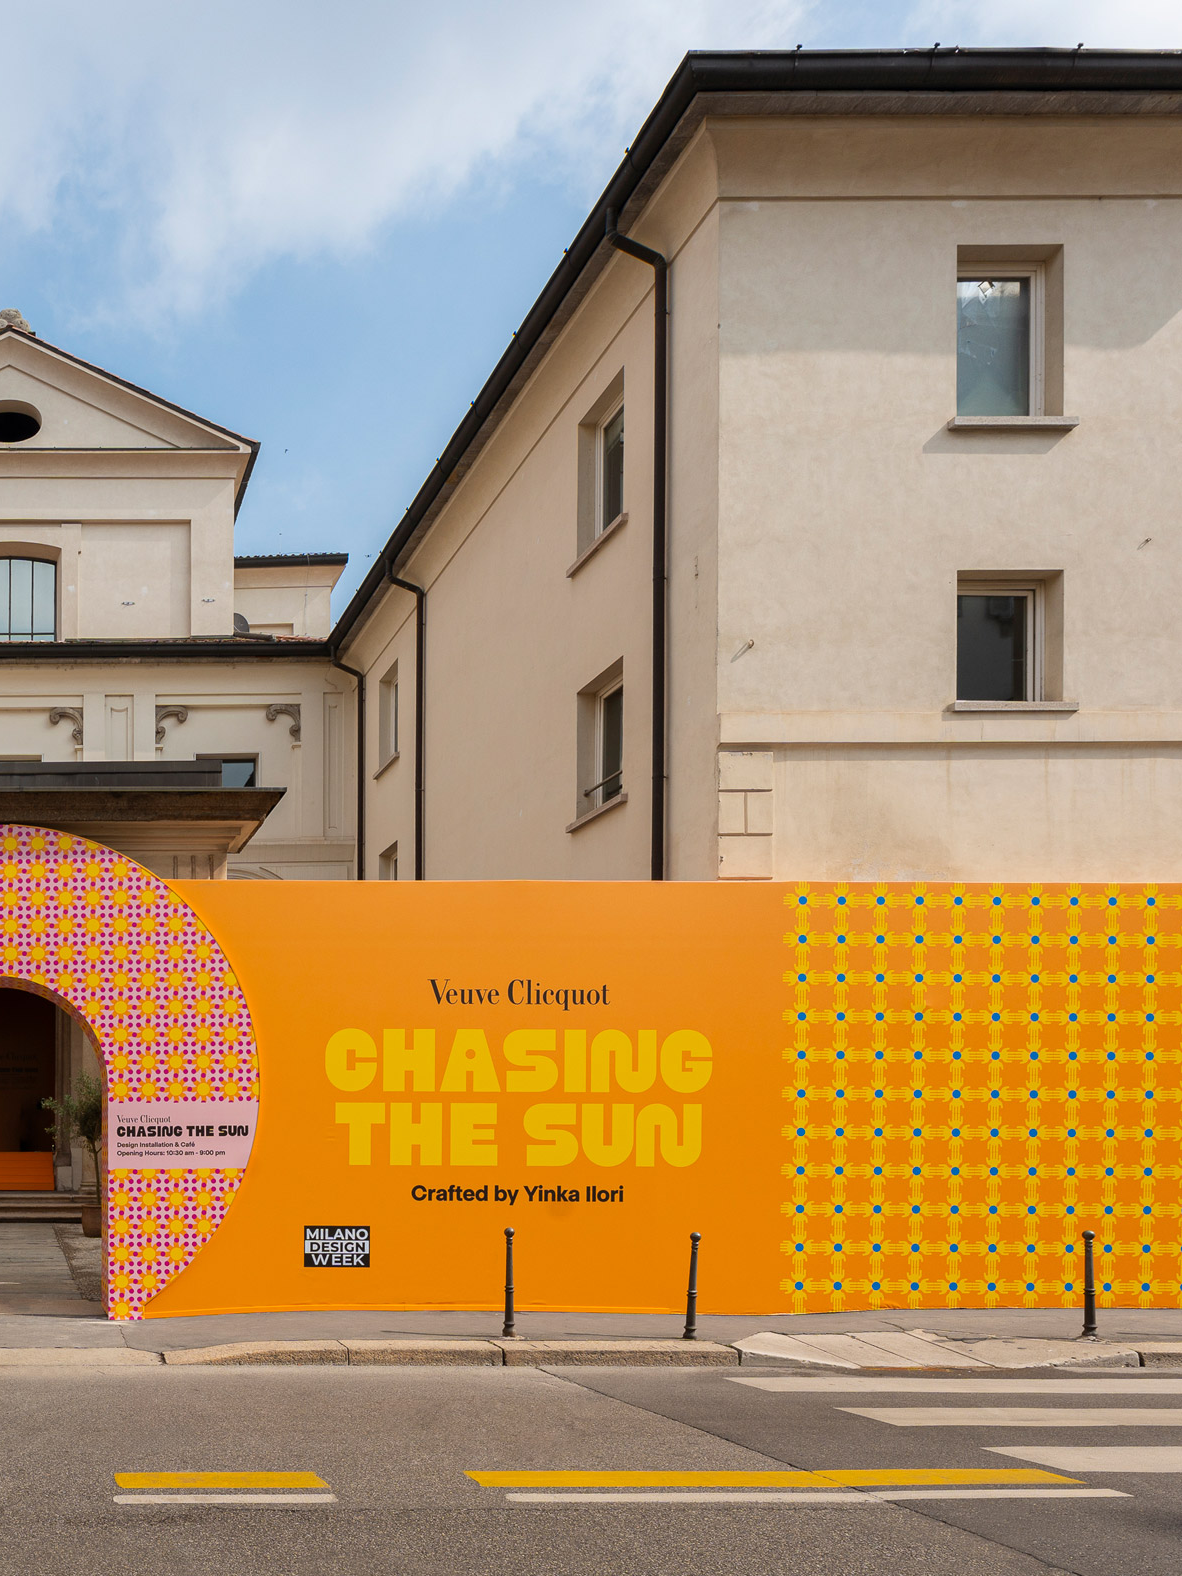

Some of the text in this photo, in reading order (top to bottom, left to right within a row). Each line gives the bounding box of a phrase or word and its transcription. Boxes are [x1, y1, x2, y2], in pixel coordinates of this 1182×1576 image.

[428, 979, 611, 1011] Veuve Clicquot
[324, 1028, 713, 1093] CHASING
[117, 1115, 171, 1124] Veuve Clicquot
[117, 1125, 249, 1137] CHASING THE SUN
[335, 1102, 703, 1167] THE SUN
[411, 1185, 624, 1206] Crafted by Yinka Ilori
[306, 1228, 369, 1240] MILANO
[310, 1242, 366, 1252] DESIGN
[311, 1254, 365, 1266] WEEK
